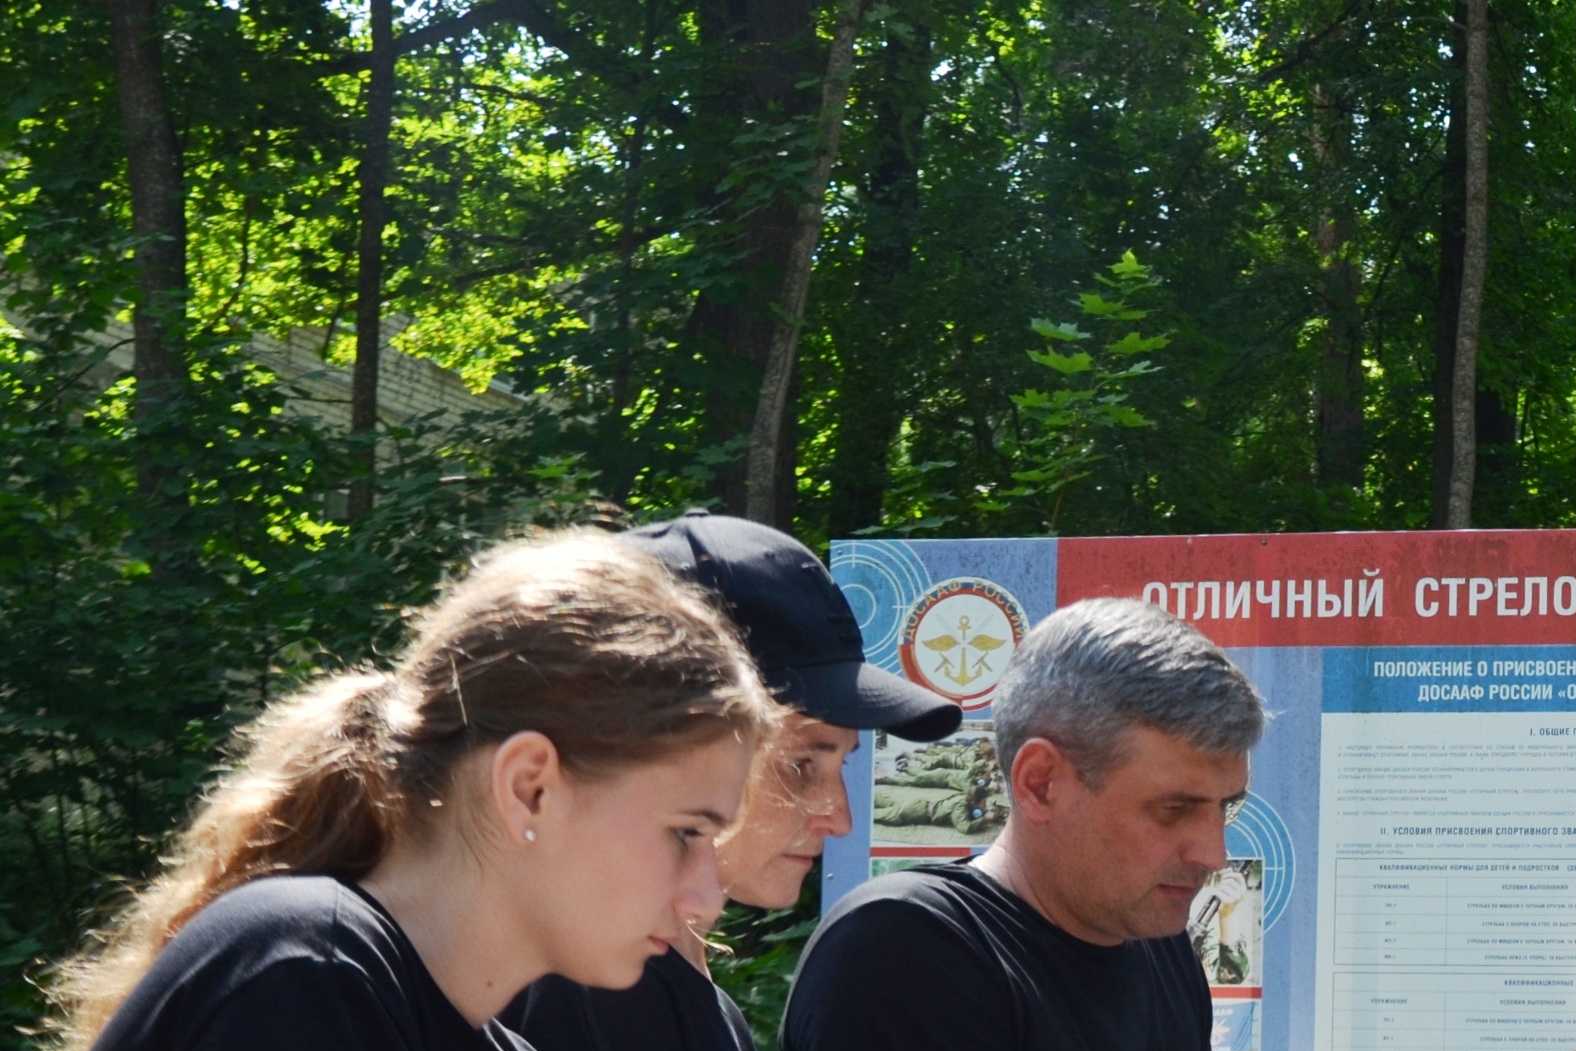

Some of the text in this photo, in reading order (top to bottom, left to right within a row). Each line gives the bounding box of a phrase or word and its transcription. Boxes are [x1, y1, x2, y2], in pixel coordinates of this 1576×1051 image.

[1142, 568, 1384, 620] ОТЛИЧНЫЙ
[902, 579, 961, 640] ДОСААФ
[1374, 661, 1472, 677] ПОЛОЖЕНИЕ
[1477, 661, 1488, 677] О
[1418, 684, 1485, 702] ДОСААФ
[1489, 684, 1553, 701] РОССИИ
[1539, 728, 1569, 736] ОБЩИЕ
[1393, 827, 1432, 835] УСЛОВИЯ
[1435, 827, 1492, 835] ПРИСВОЕНИЯ
[1495, 827, 1558, 835] СПОРТИВНОГО
